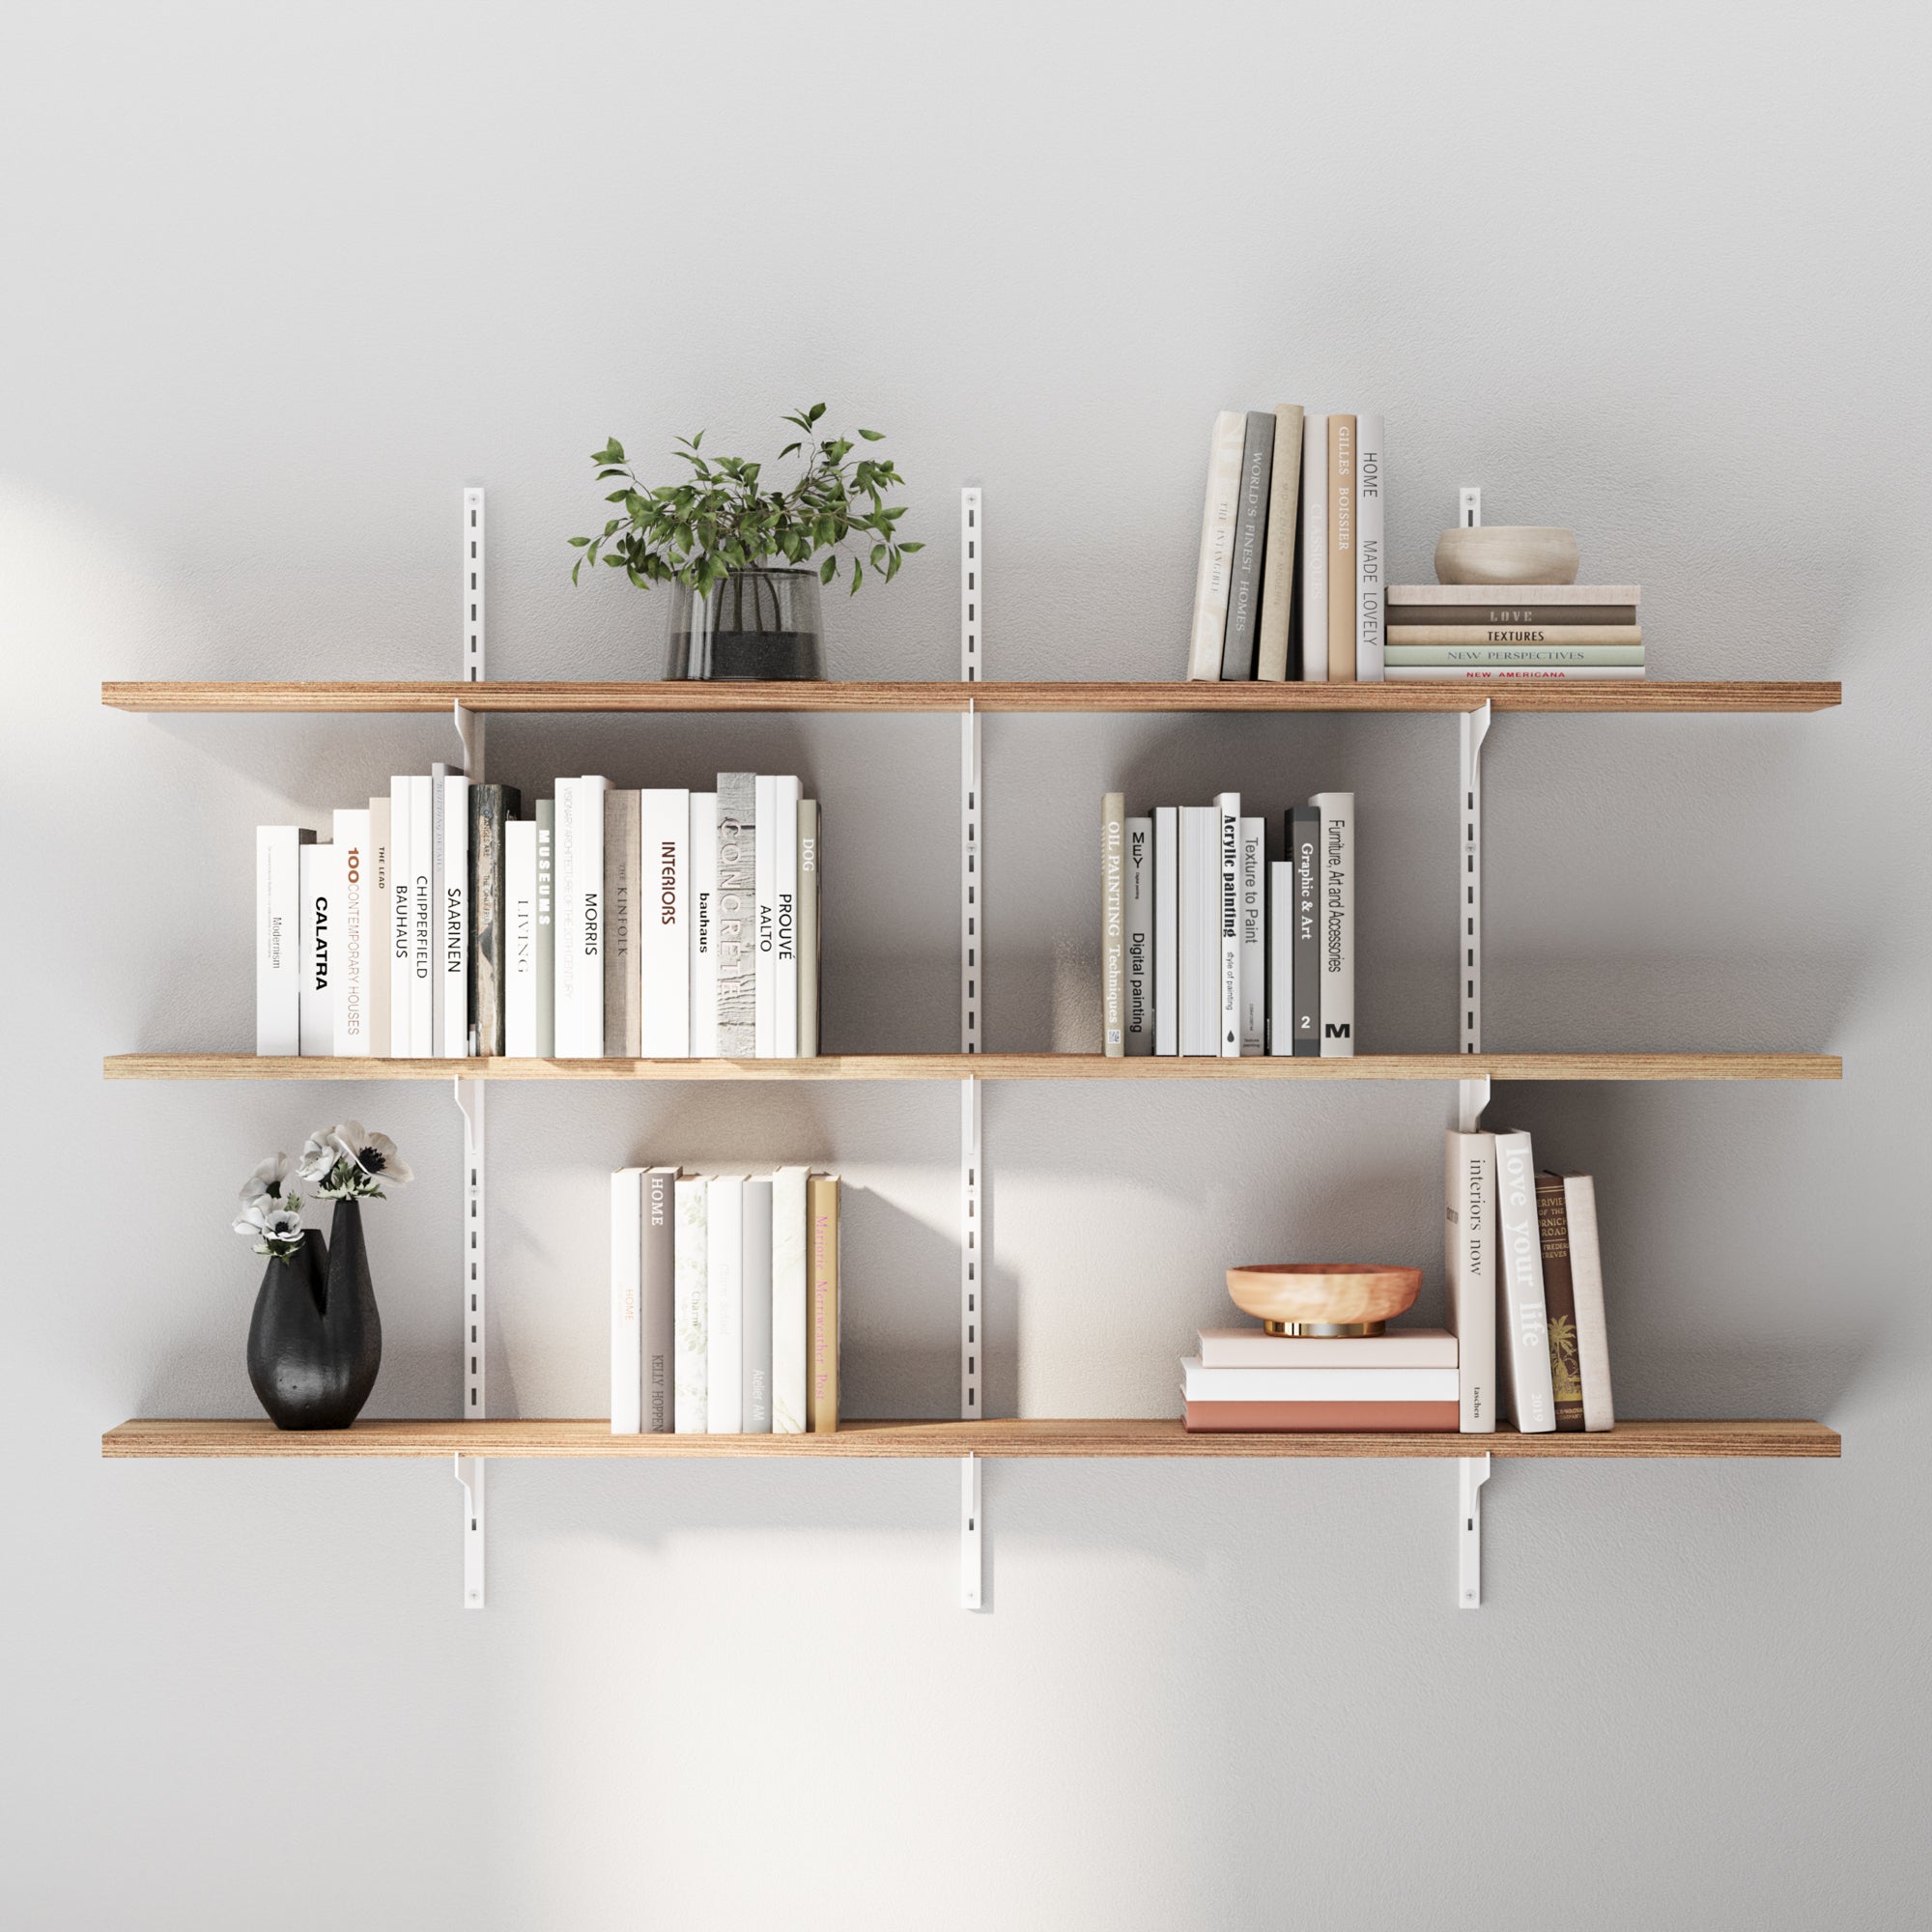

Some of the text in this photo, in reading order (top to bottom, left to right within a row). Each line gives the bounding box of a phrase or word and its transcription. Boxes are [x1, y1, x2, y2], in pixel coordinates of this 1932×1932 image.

[1339, 427, 1350, 551] GILLES BOISSIER
[1236, 452, 1263, 632] WORLD'S FINEST HOMES
[1363, 452, 1378, 645] HOME MADE LOVELY
[1488, 632, 1544, 641] TEXTURES
[1490, 611, 1532, 622] LOVE
[803, 838, 813, 871] DOG
[1108, 821, 1121, 850] OIL
[539, 830, 550, 925] MUSEUMS
[662, 842, 675, 924] INTERIORS
[720, 818, 741, 997] CONCRETE
[1108, 856, 1121, 937] PAINTING
[1223, 815, 1236, 937] Acrylic painting
[1244, 838, 1258, 943] Texture to Paint
[1298, 842, 1314, 939] Graphic & Art
[1326, 820, 1345, 972] Furniture, Art and Accessories
[272, 917, 282, 969] Modernism
[315, 896, 328, 991] CALATRA
[396, 886, 408, 958] BAUHAUS
[417, 875, 427, 979] CHIPPERFIELD
[448, 889, 461, 972] SAARINEN
[518, 900, 528, 973] LIVING
[585, 894, 597, 955] MORRIS
[618, 887, 628, 956] KINFOLK
[699, 893, 709, 952] bauhaus
[760, 905, 771, 952] AALTO
[779, 895, 794, 960] PROUVÉ
[1107, 945, 1121, 1023] Techniques
[1129, 933, 1144, 1034] Digital painting
[1226, 952, 1235, 969] style
[348, 987, 359, 1036] HOUSES
[1301, 1016, 1310, 1028] 2
[1325, 1024, 1350, 1037] M
[651, 1179, 663, 1225] HOME
[1470, 1159, 1486, 1275] interiors now
[1542, 1198, 1565, 1207] RIVIE
[1542, 1227, 1567, 1236] ROAD
[813, 1216, 827, 1401] Marjorie Merriweather Post
[1506, 1147, 1546, 1422] love your life 2019
[652, 1354, 663, 1432] KELLY HOPPEN
[753, 1370, 765, 1421] Atelier AM
